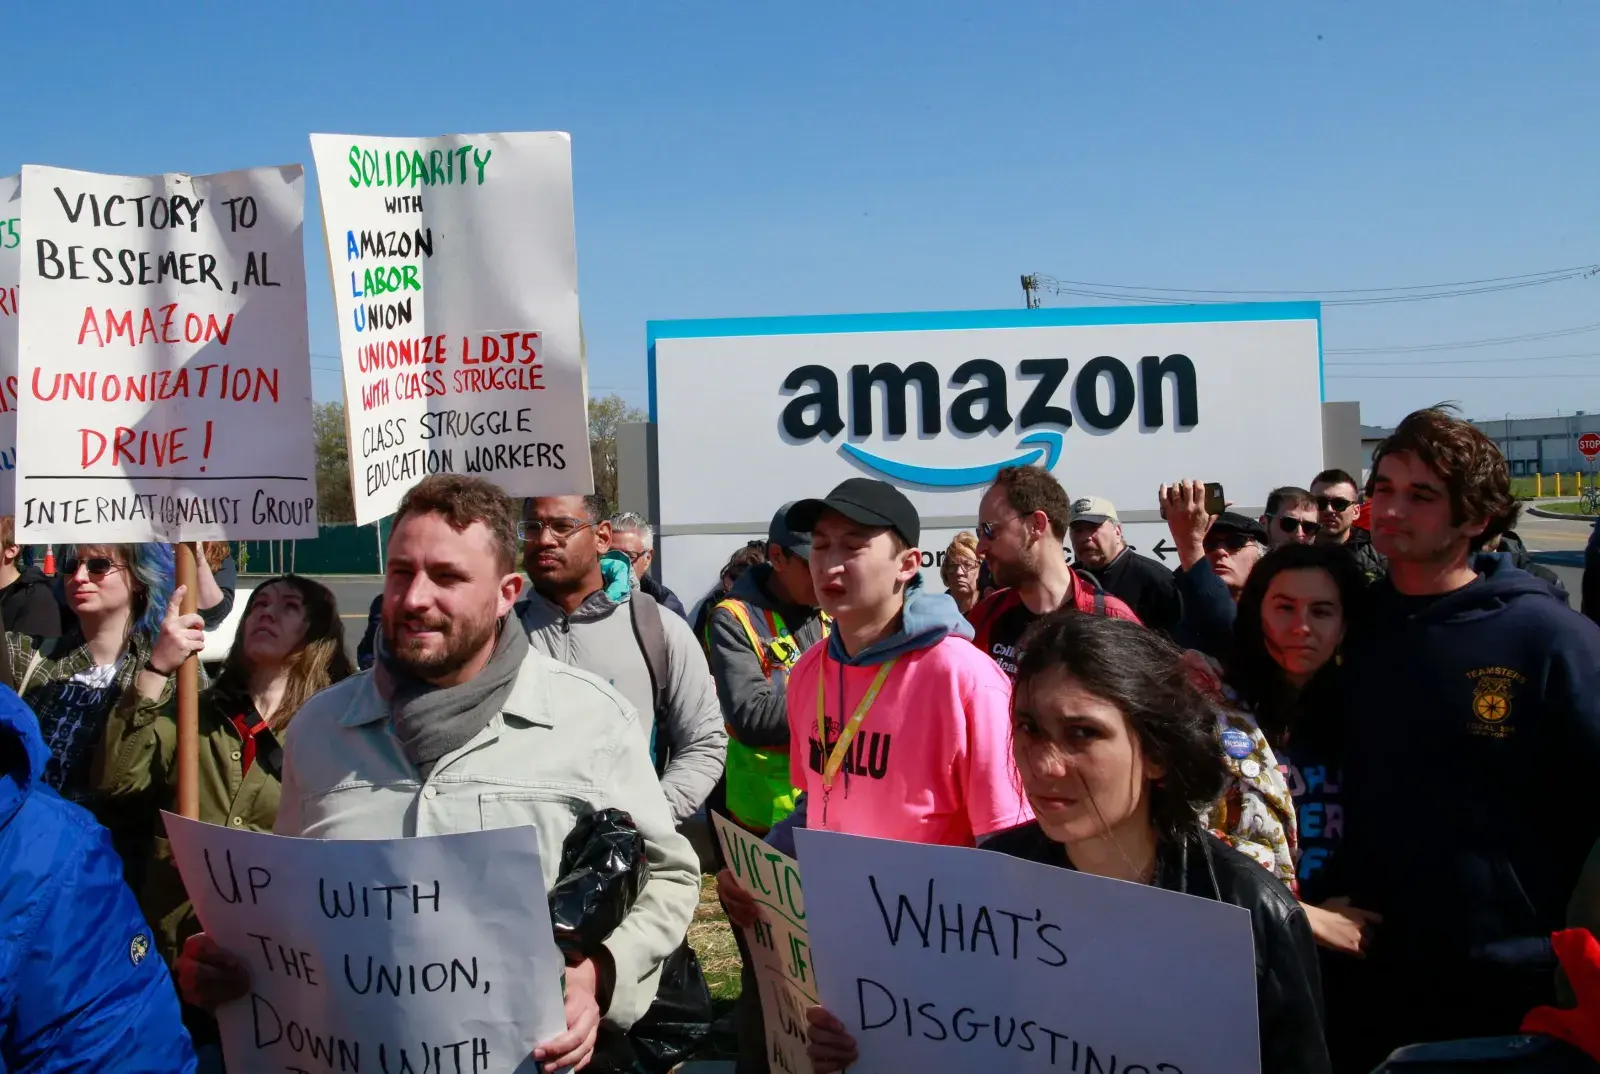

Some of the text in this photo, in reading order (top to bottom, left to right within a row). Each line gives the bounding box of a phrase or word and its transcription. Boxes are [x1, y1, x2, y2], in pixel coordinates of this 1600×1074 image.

[348, 145, 492, 188] SOLIDARITY
[54, 186, 258, 234] VICTORY TO
[385, 195, 424, 215] WITH
[37, 239, 281, 294] BESSEMER, AL
[347, 228, 433, 262] AMAZON
[352, 265, 421, 298] LABOR
[77, 303, 234, 348] AMAZON
[354, 297, 412, 332] UNION
[358, 332, 538, 374] UNIONIZE LDJ5
[31, 364, 279, 402] UNIONIZATION
[361, 364, 546, 411] WITH CLASS STRUGGLE
[782, 353, 1199, 438] amazon
[78, 421, 213, 473] DRIVE!
[362, 408, 532, 458] CLASS STRUGGLE
[1580, 440, 1600, 449] STOP
[367, 443, 566, 497] EDUCATION WORKERS
[23, 489, 313, 528] INTERNATIONALIST GROUP
[204, 848, 440, 920] UP WITH
[753, 920, 774, 951] AT
[868, 875, 1068, 967] WHAT'S
[246, 932, 490, 997] THE UNION,
[788, 931, 818, 994] JF
[251, 993, 360, 1073] DOWN
